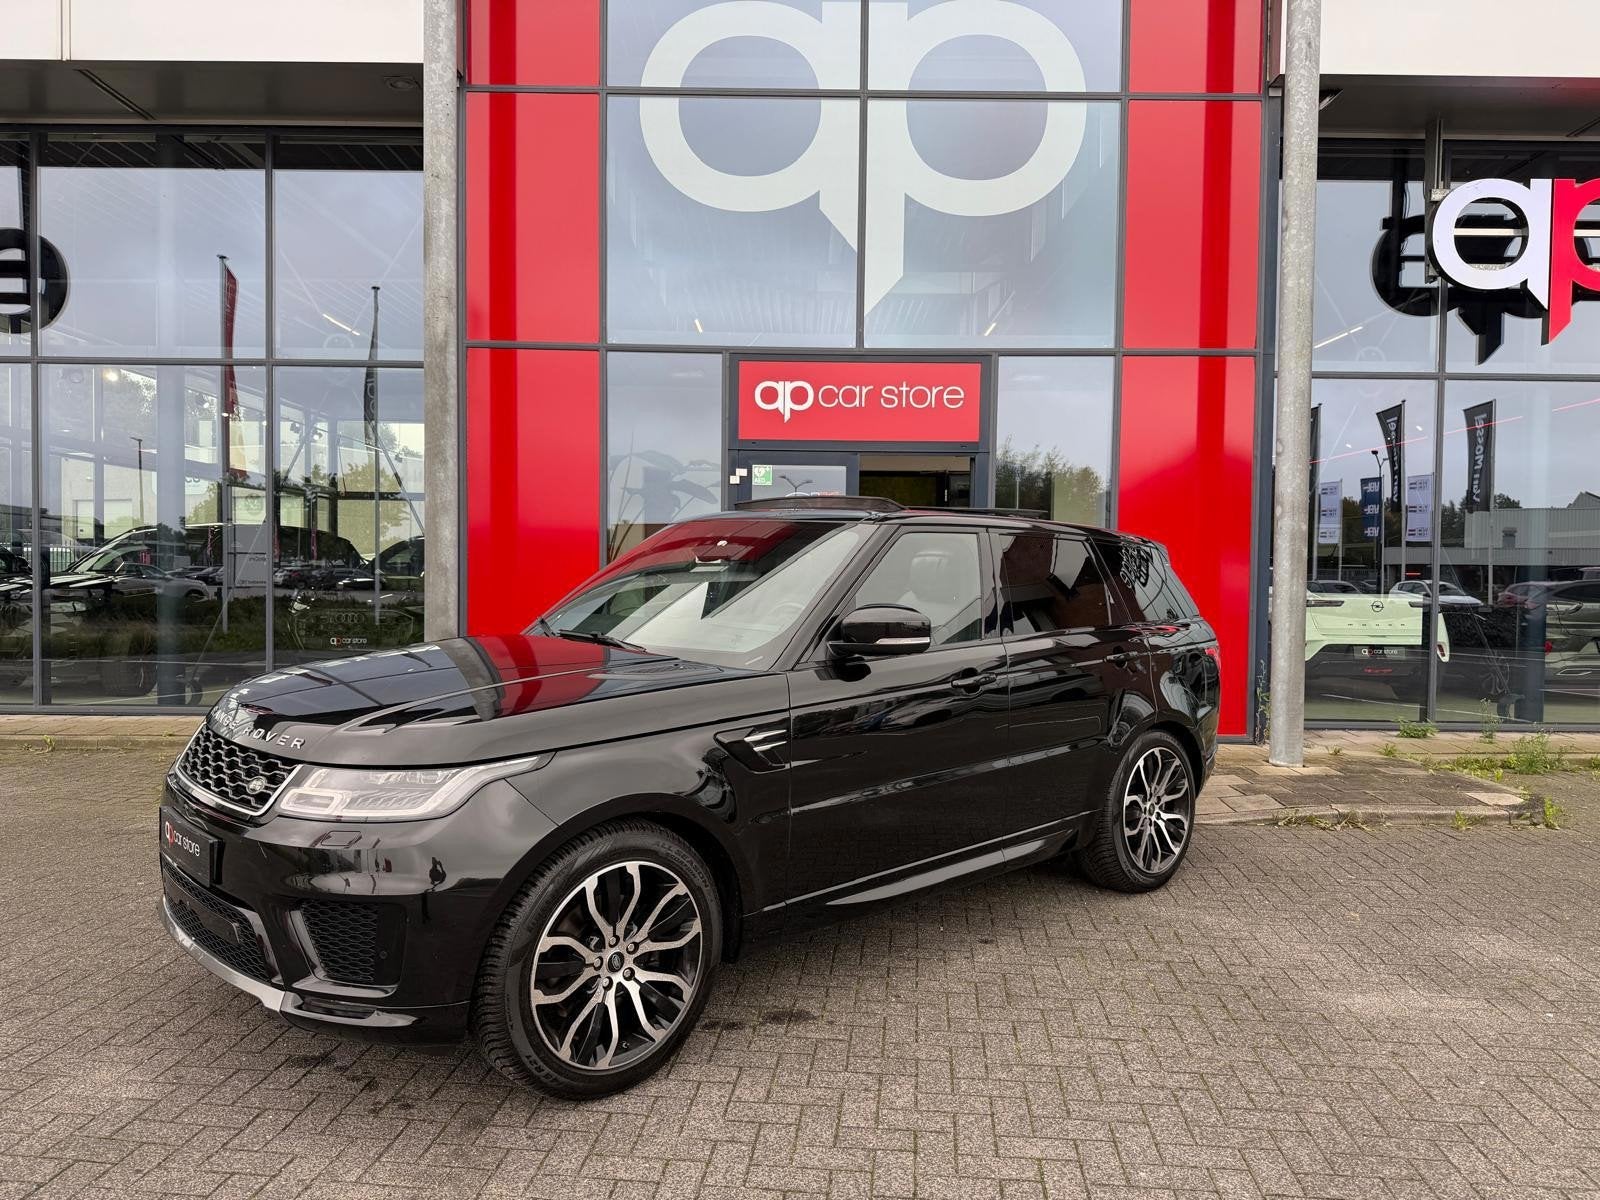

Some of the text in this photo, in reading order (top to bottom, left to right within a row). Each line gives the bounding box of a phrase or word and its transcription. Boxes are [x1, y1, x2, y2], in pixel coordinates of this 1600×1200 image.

[754, 380, 964, 423] ap car store
[243, 726, 306, 750] ROVER
[173, 830, 182, 846] car
[182, 836, 201, 857] store
